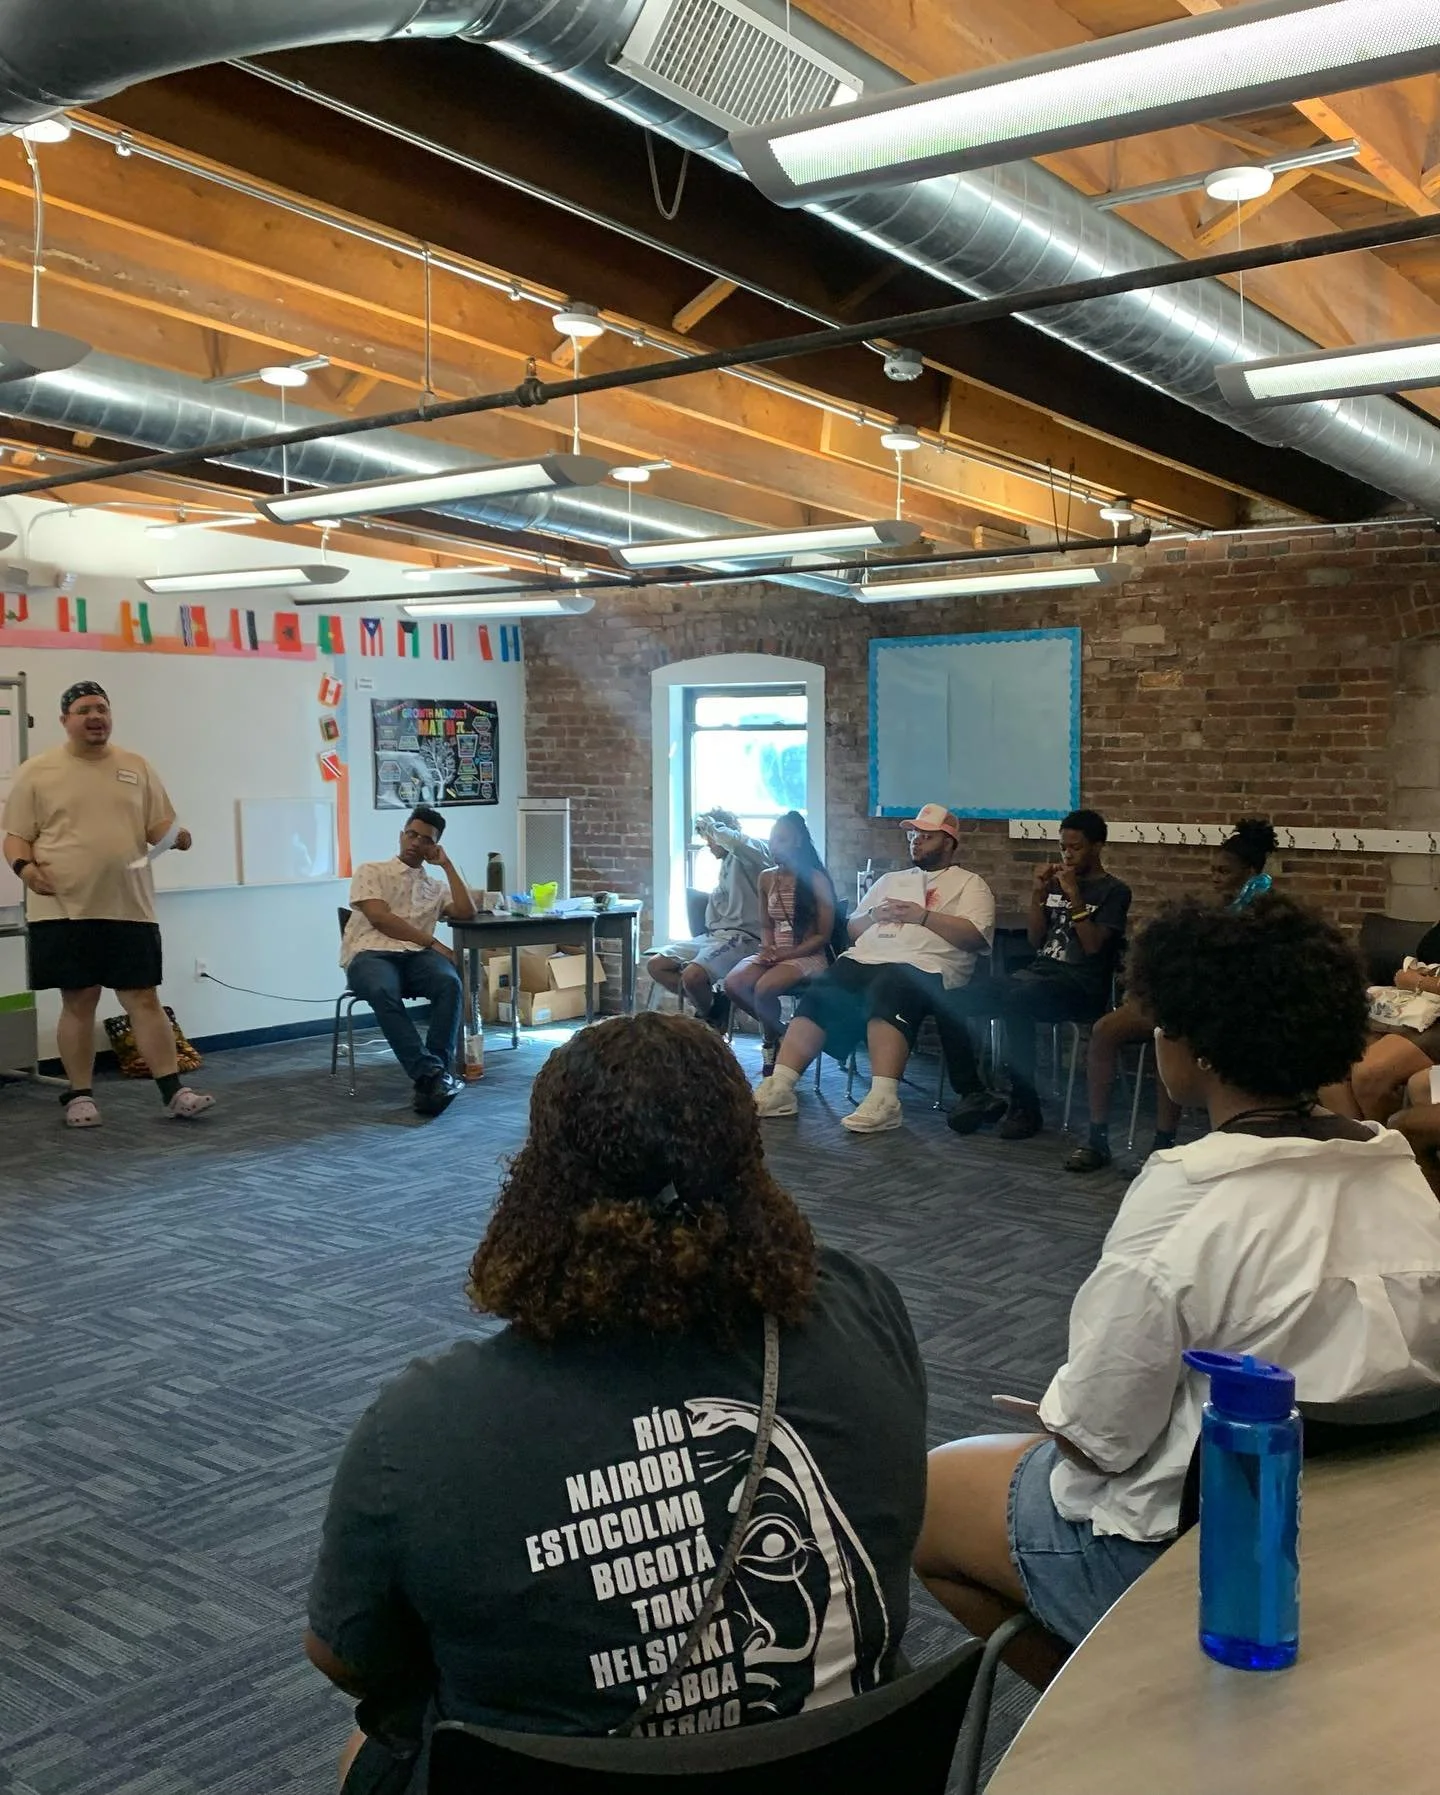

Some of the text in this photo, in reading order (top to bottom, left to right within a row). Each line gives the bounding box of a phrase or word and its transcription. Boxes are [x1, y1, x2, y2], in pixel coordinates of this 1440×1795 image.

[402, 708, 466, 719] GROWTH MINDSET
[418, 719, 456, 736] MATH
[632, 1405, 685, 1452] RÍO
[565, 1447, 696, 1514] NAIROBI
[525, 1490, 705, 1573] ESTOCOLMO
[590, 1527, 717, 1601] BOGOTÁ
[589, 1618, 734, 1689] HELSINKI
[608, 1698, 741, 1738] ERMO
